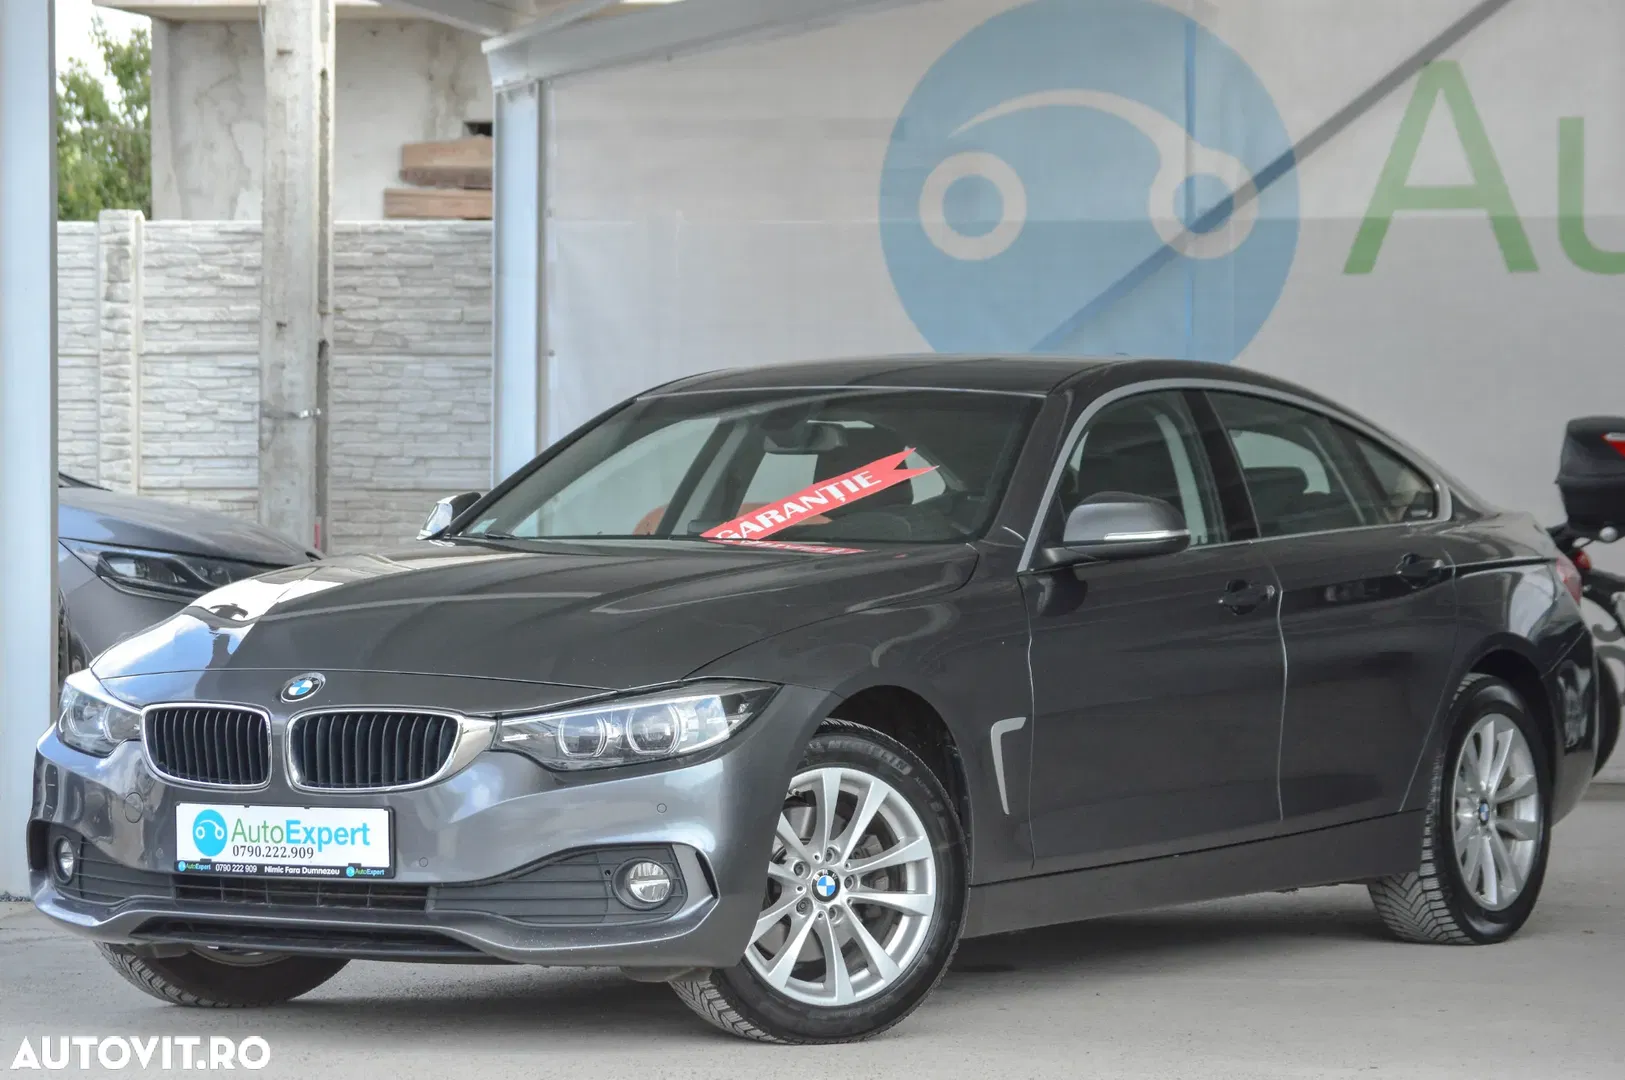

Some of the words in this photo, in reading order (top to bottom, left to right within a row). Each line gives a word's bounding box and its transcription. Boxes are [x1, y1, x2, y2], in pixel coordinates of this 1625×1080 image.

[231, 818, 371, 852] AutoExpert
[232, 845, 314, 859] 0790.222.909
[186, 863, 211, 871] AutoExpert
[215, 863, 231, 872] 0790
[232, 864, 244, 872] 222
[245, 865, 257, 873] 909
[285, 866, 300, 874] Fara
[301, 866, 340, 875] Dumnezeu
[355, 868, 385, 876] AutoExpert
